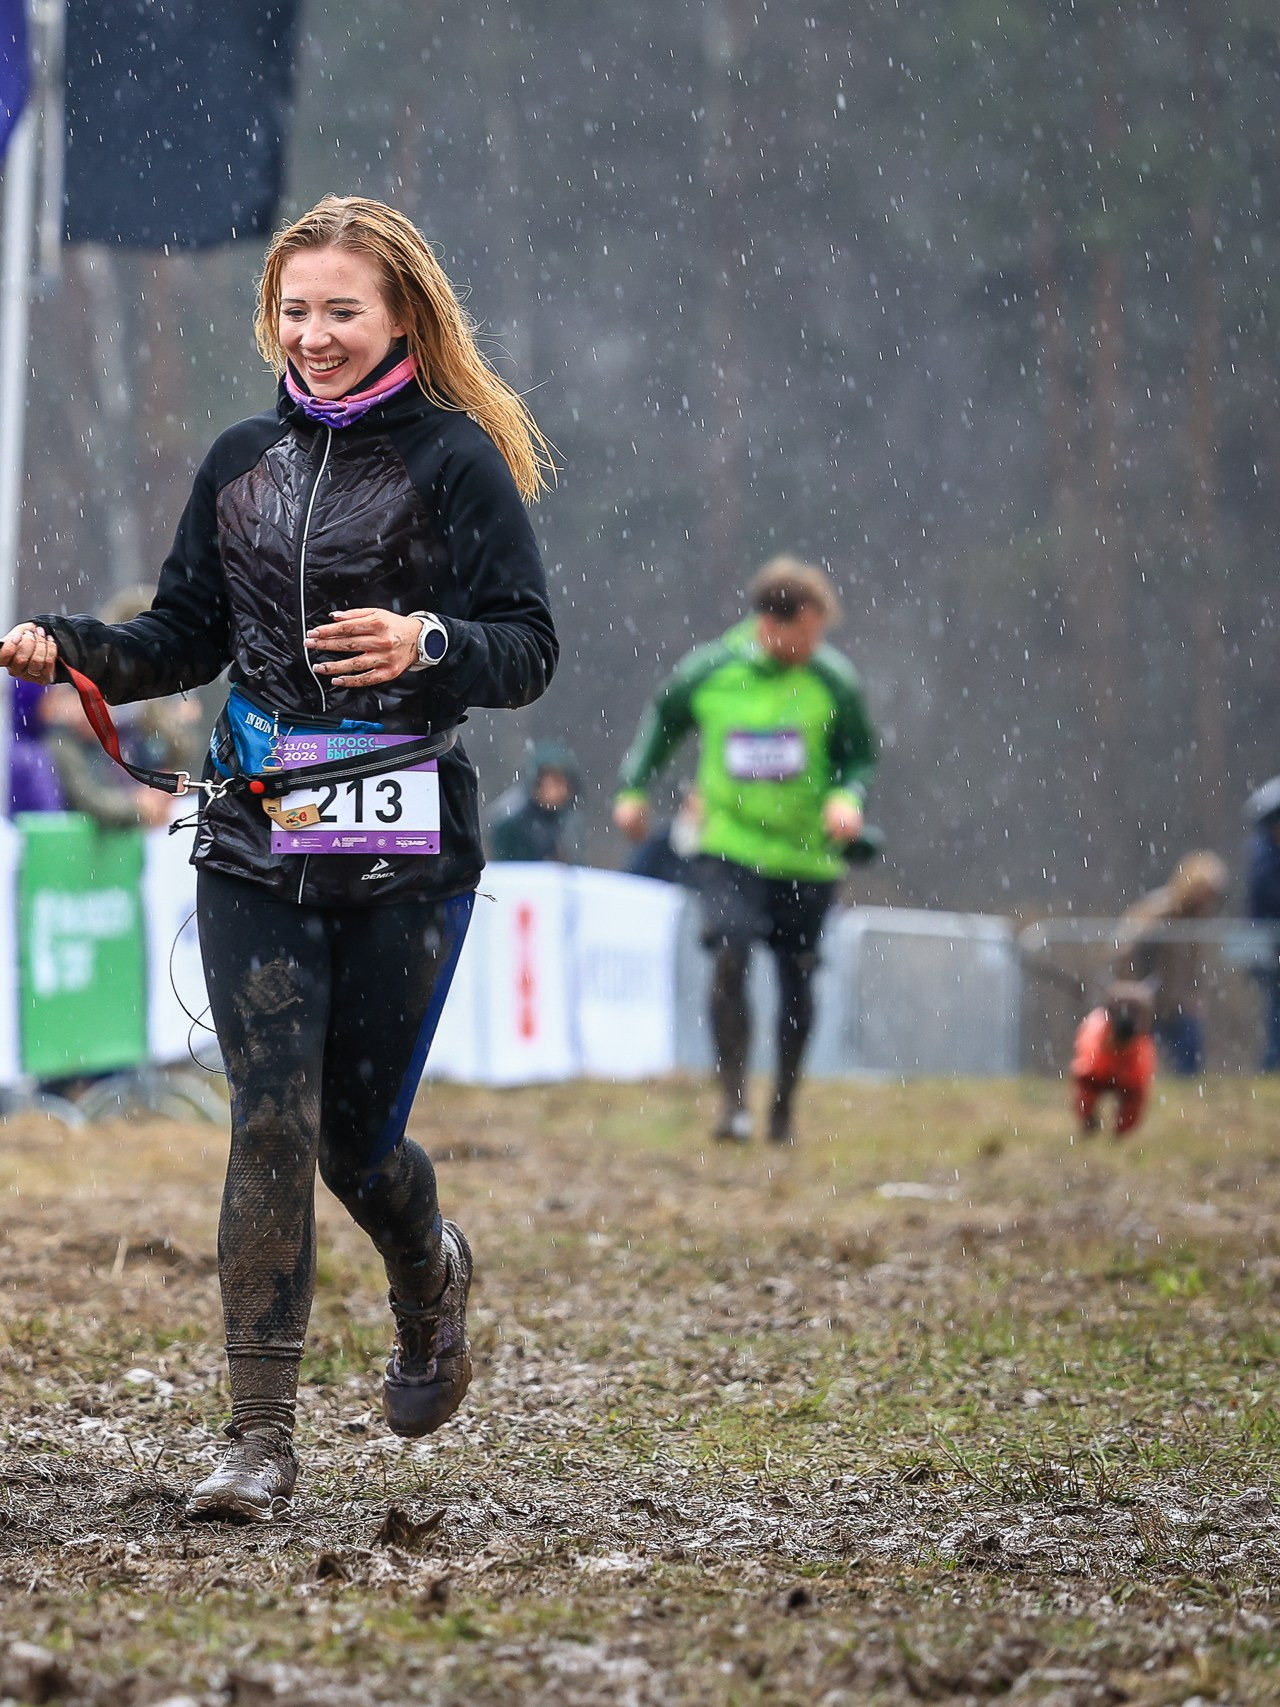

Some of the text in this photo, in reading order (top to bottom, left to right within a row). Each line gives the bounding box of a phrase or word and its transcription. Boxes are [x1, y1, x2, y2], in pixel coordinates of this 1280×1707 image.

[283, 742, 318, 751] 11/04
[283, 751, 318, 761] 2026
[311, 778, 402, 823] 213
[360, 871, 396, 881] DEMIX
